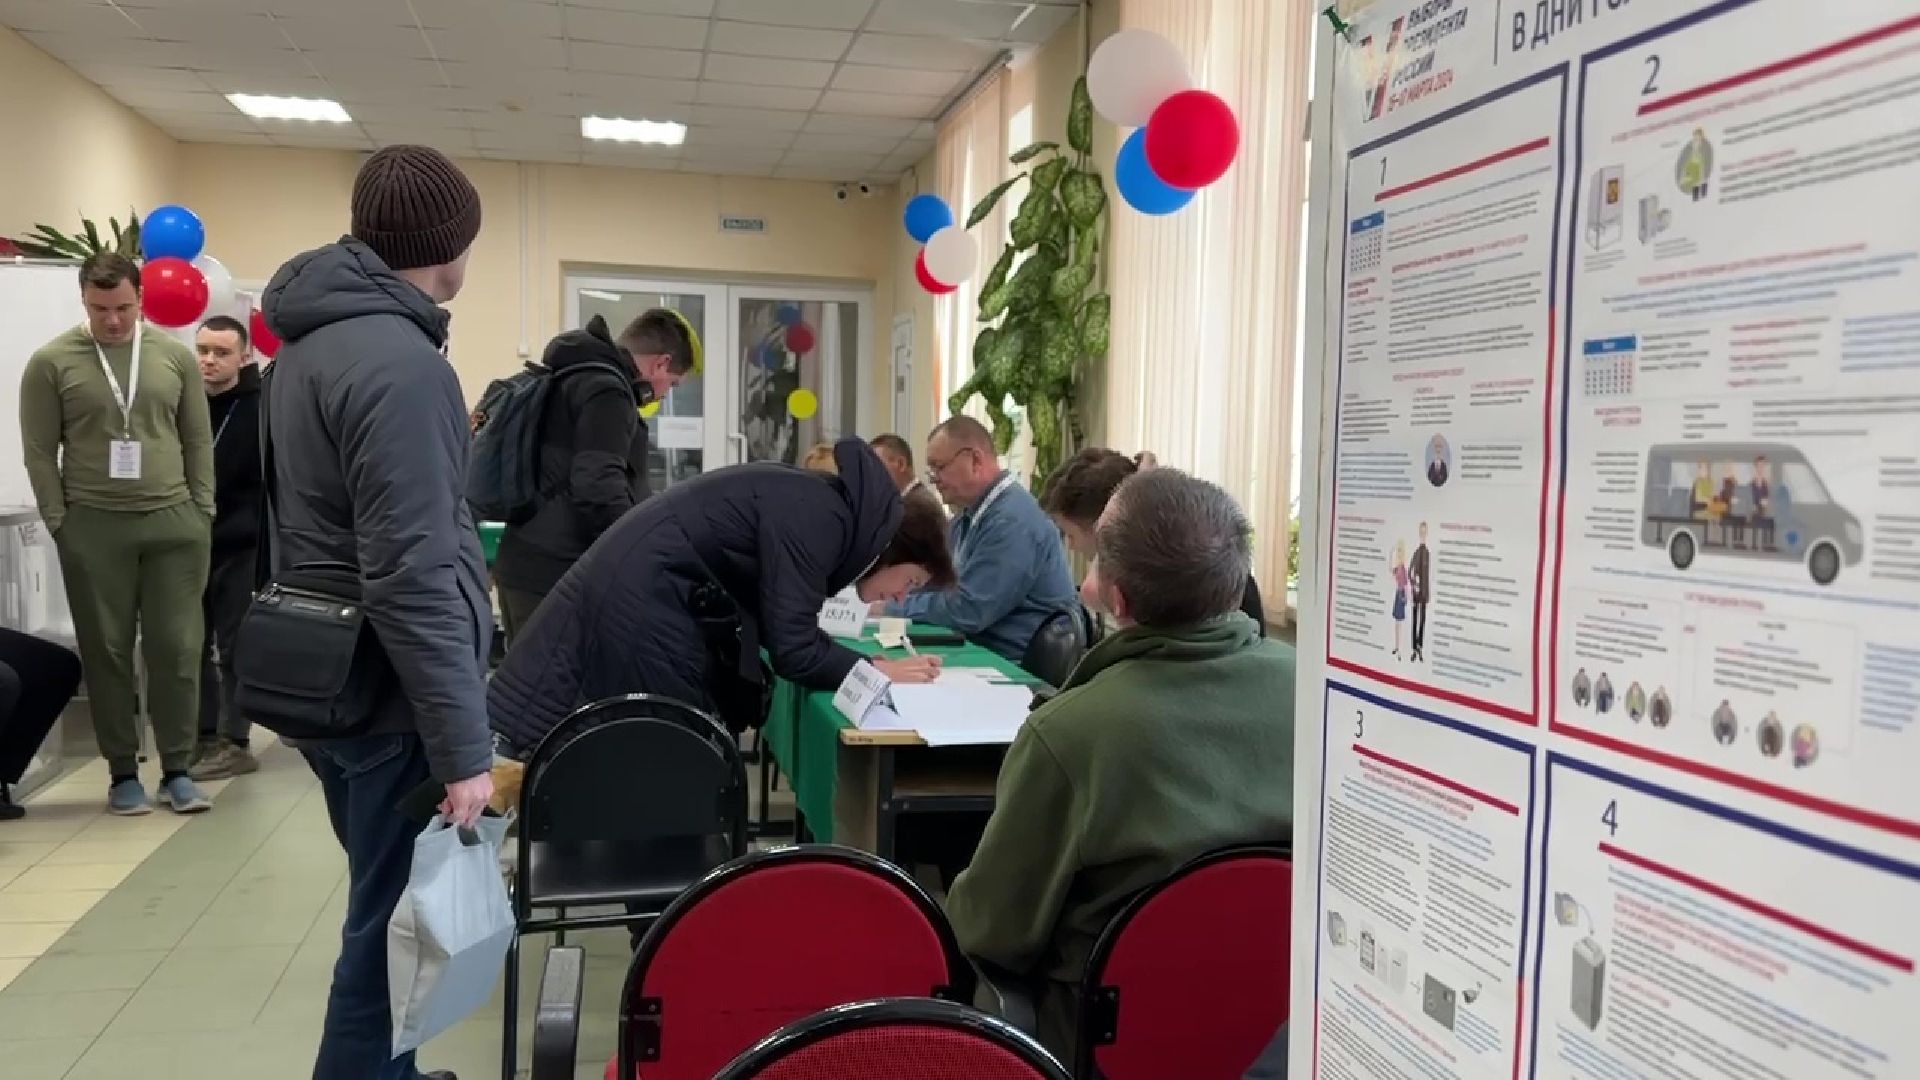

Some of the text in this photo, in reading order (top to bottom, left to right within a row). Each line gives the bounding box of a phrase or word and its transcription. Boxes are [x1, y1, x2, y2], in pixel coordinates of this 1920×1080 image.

[1512, 0, 1583, 52] В ДНИ
[1641, 55, 1660, 95] 2
[1380, 156, 1388, 186] 1
[1354, 710, 1365, 738] 3
[1601, 800, 1619, 836] 4
